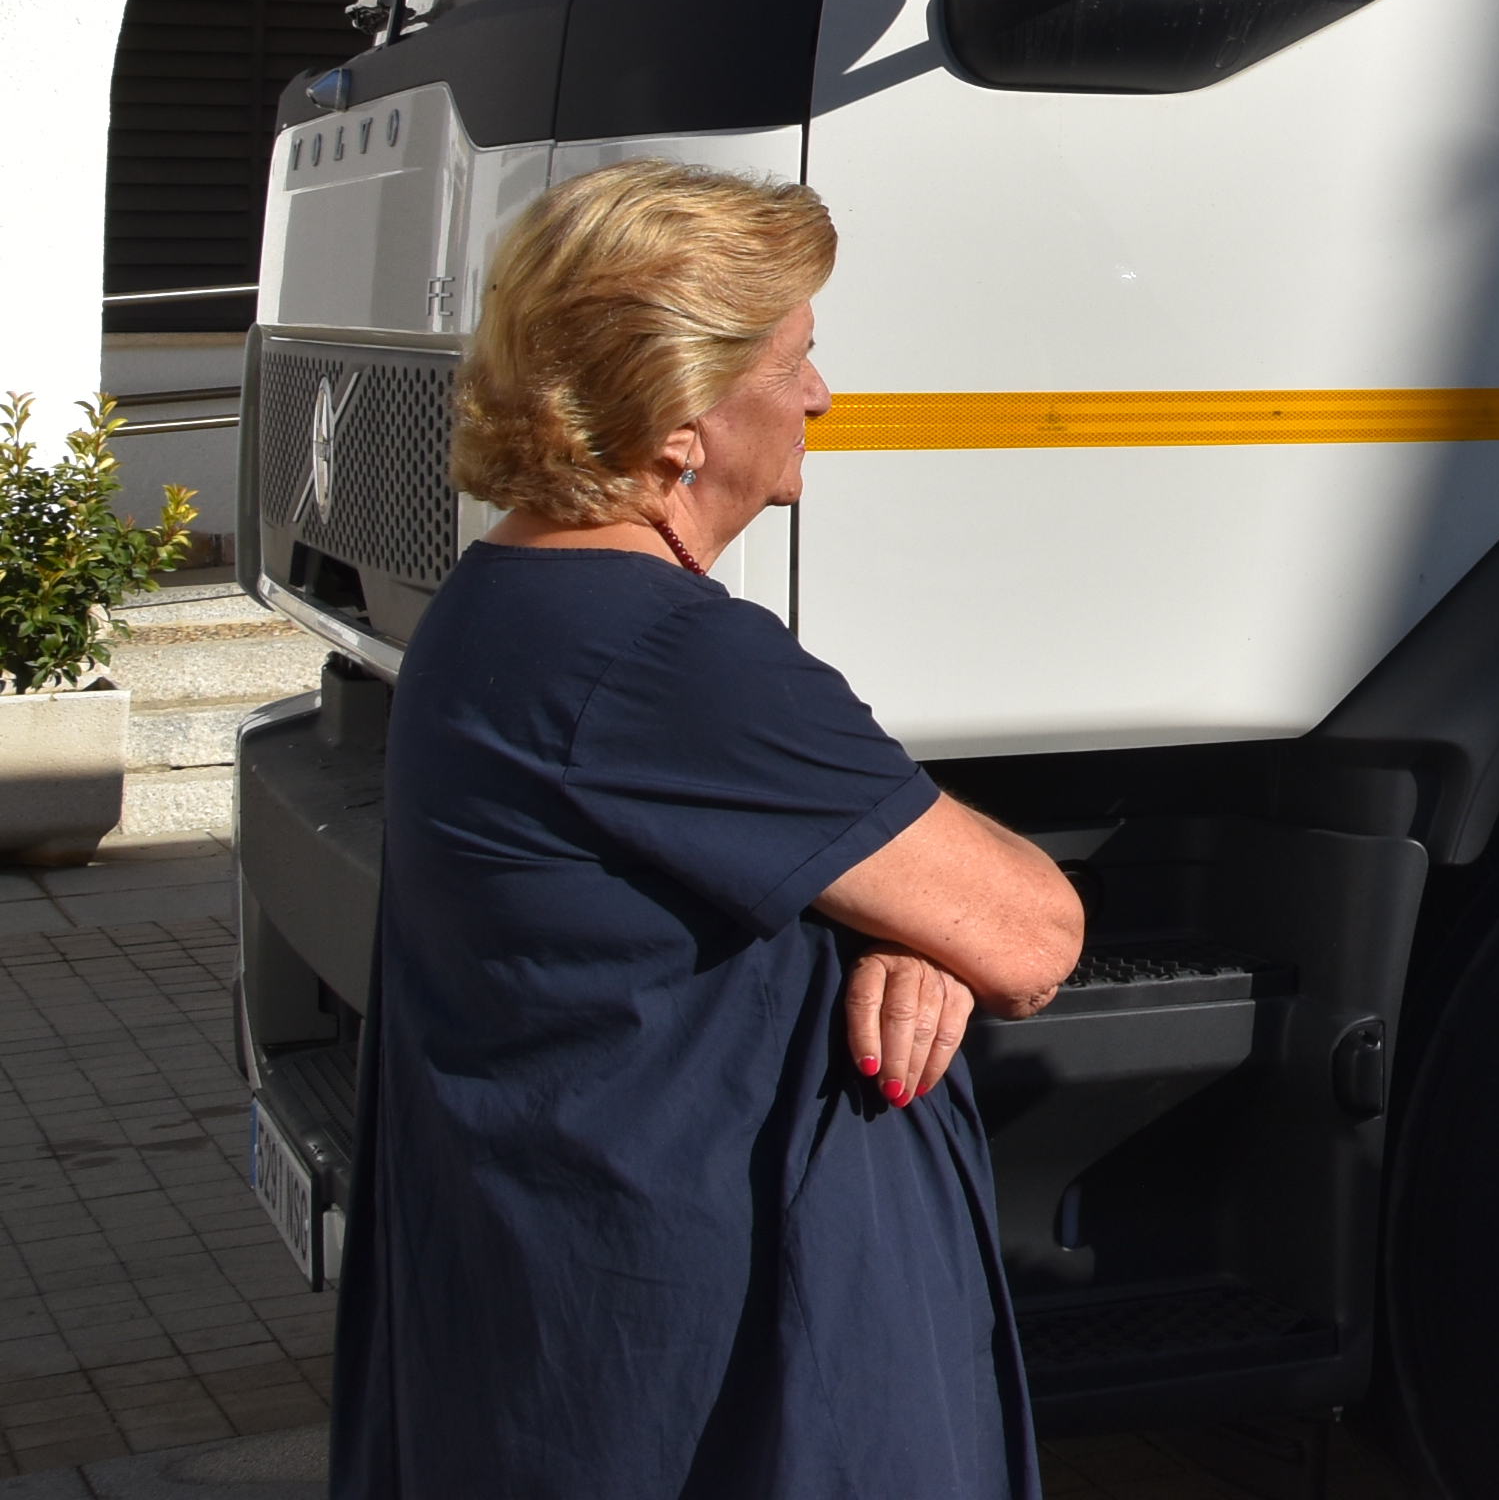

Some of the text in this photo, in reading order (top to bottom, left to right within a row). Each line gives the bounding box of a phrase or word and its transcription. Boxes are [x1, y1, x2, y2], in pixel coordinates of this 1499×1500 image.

[292, 108, 401, 171] VOLVO
[425, 276, 456, 317] FE
[257, 1120, 308, 1261] 5291 NSG
